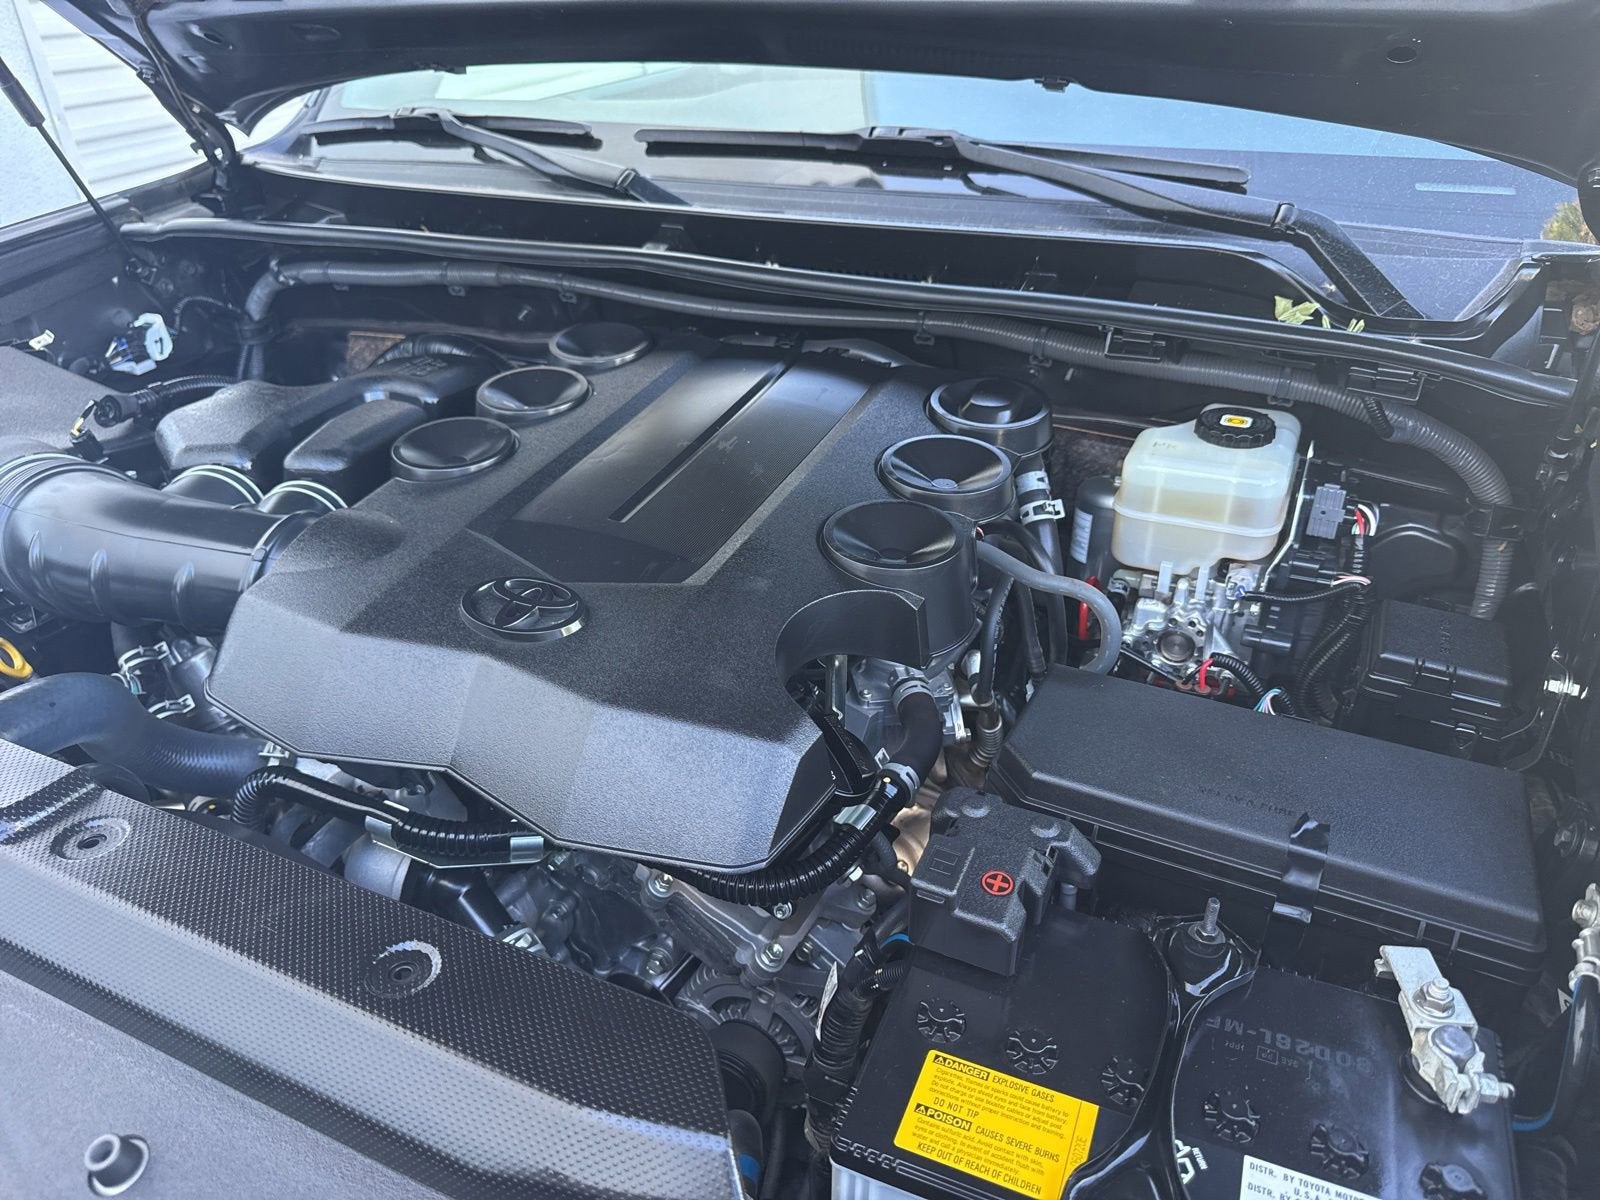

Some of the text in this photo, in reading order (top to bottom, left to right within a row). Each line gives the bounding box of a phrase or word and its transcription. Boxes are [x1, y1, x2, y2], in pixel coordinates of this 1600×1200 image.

[944, 1058, 1055, 1102] DANGER EXPLOSIVE GASES
[932, 1096, 980, 1119] DO NOT TIP
[925, 1107, 1061, 1162] POISON CAUSES SEVERE BURNS
[916, 1141, 1043, 1194] KEEP OUT OF REACH OF CHILDREN
[1014, 1152, 1029, 1161] with
[1247, 1182, 1276, 1198] DISTR.
[1249, 1161, 1277, 1177] DISTR.
[1283, 1173, 1294, 1183] BY
[1298, 1177, 1331, 1195] TOYOTA
